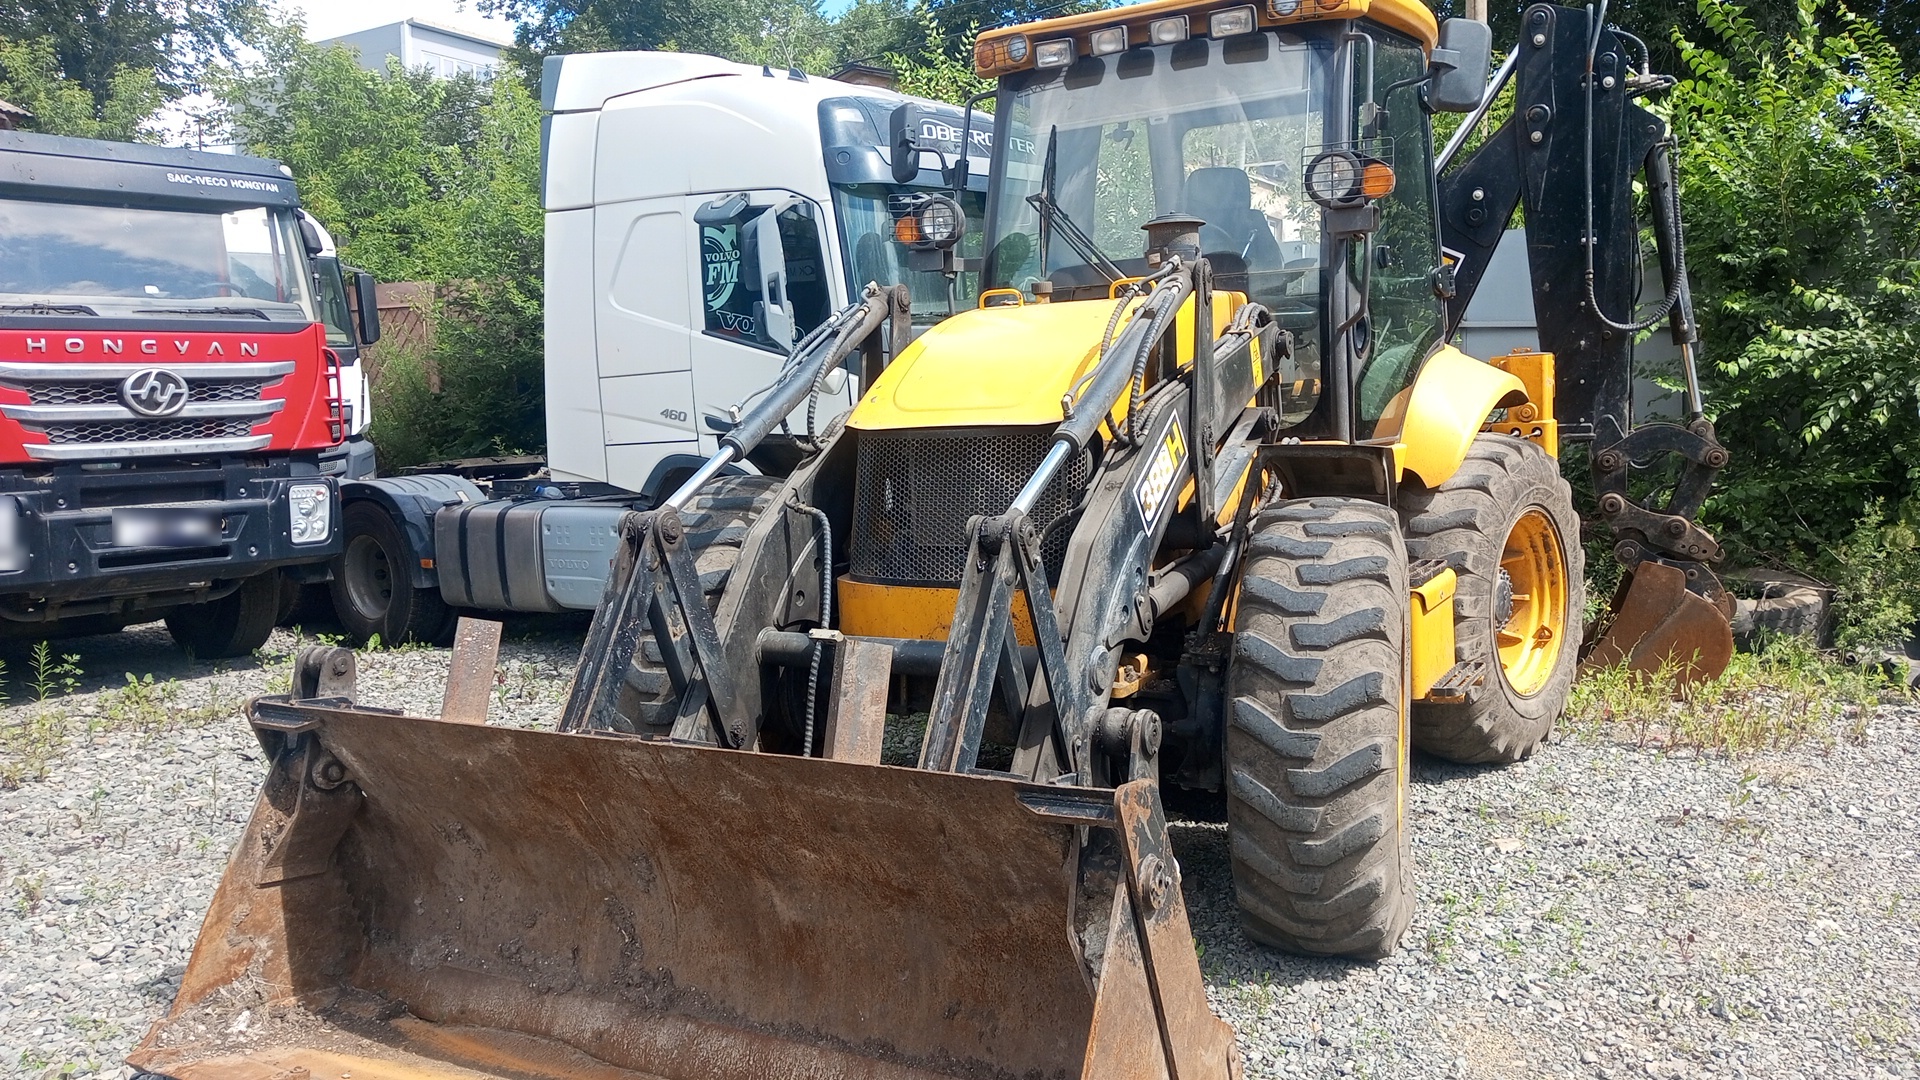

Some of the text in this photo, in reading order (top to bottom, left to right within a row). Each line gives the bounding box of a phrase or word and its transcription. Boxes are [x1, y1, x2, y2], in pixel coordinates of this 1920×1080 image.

[166, 173, 280, 193] SAIC-IVECO HONGYAN
[704, 249, 741, 262] VOLVO
[706, 260, 740, 286] FM
[26, 338, 259, 356] HONGYAN
[659, 408, 688, 423] 460
[1139, 421, 1185, 522] 388H
[547, 558, 589, 570] VOLVO
